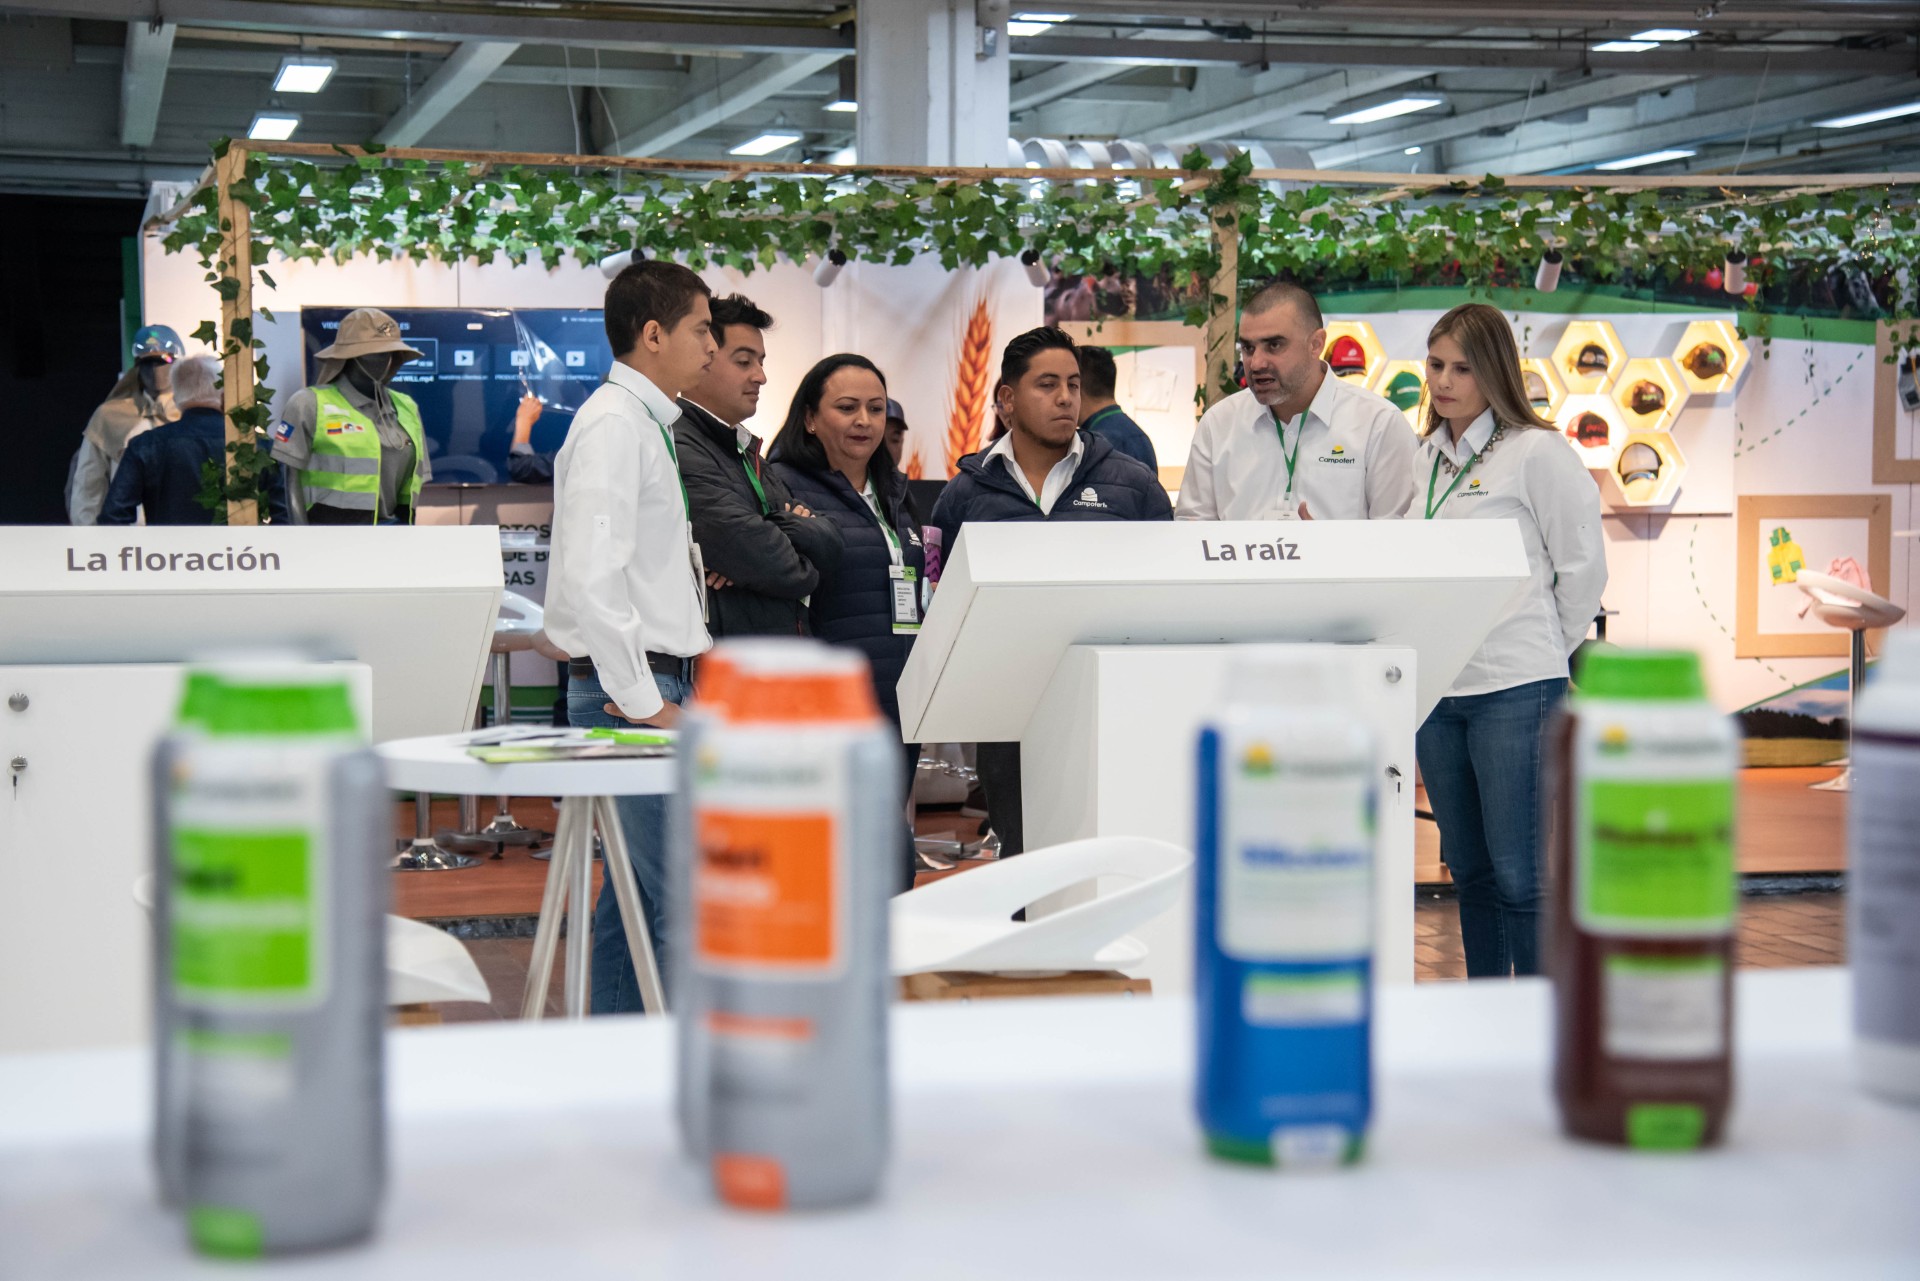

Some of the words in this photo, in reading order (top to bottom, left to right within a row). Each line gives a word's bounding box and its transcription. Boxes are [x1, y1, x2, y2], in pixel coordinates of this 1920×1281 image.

[1318, 456, 1355, 465] Campofert
[1457, 490, 1489, 498] Campofert
[1073, 499, 1105, 508] Campofert
[1201, 539, 1237, 561] La
[1245, 537, 1301, 561] raíz
[67, 547, 107, 571] La
[117, 546, 281, 571] floración
